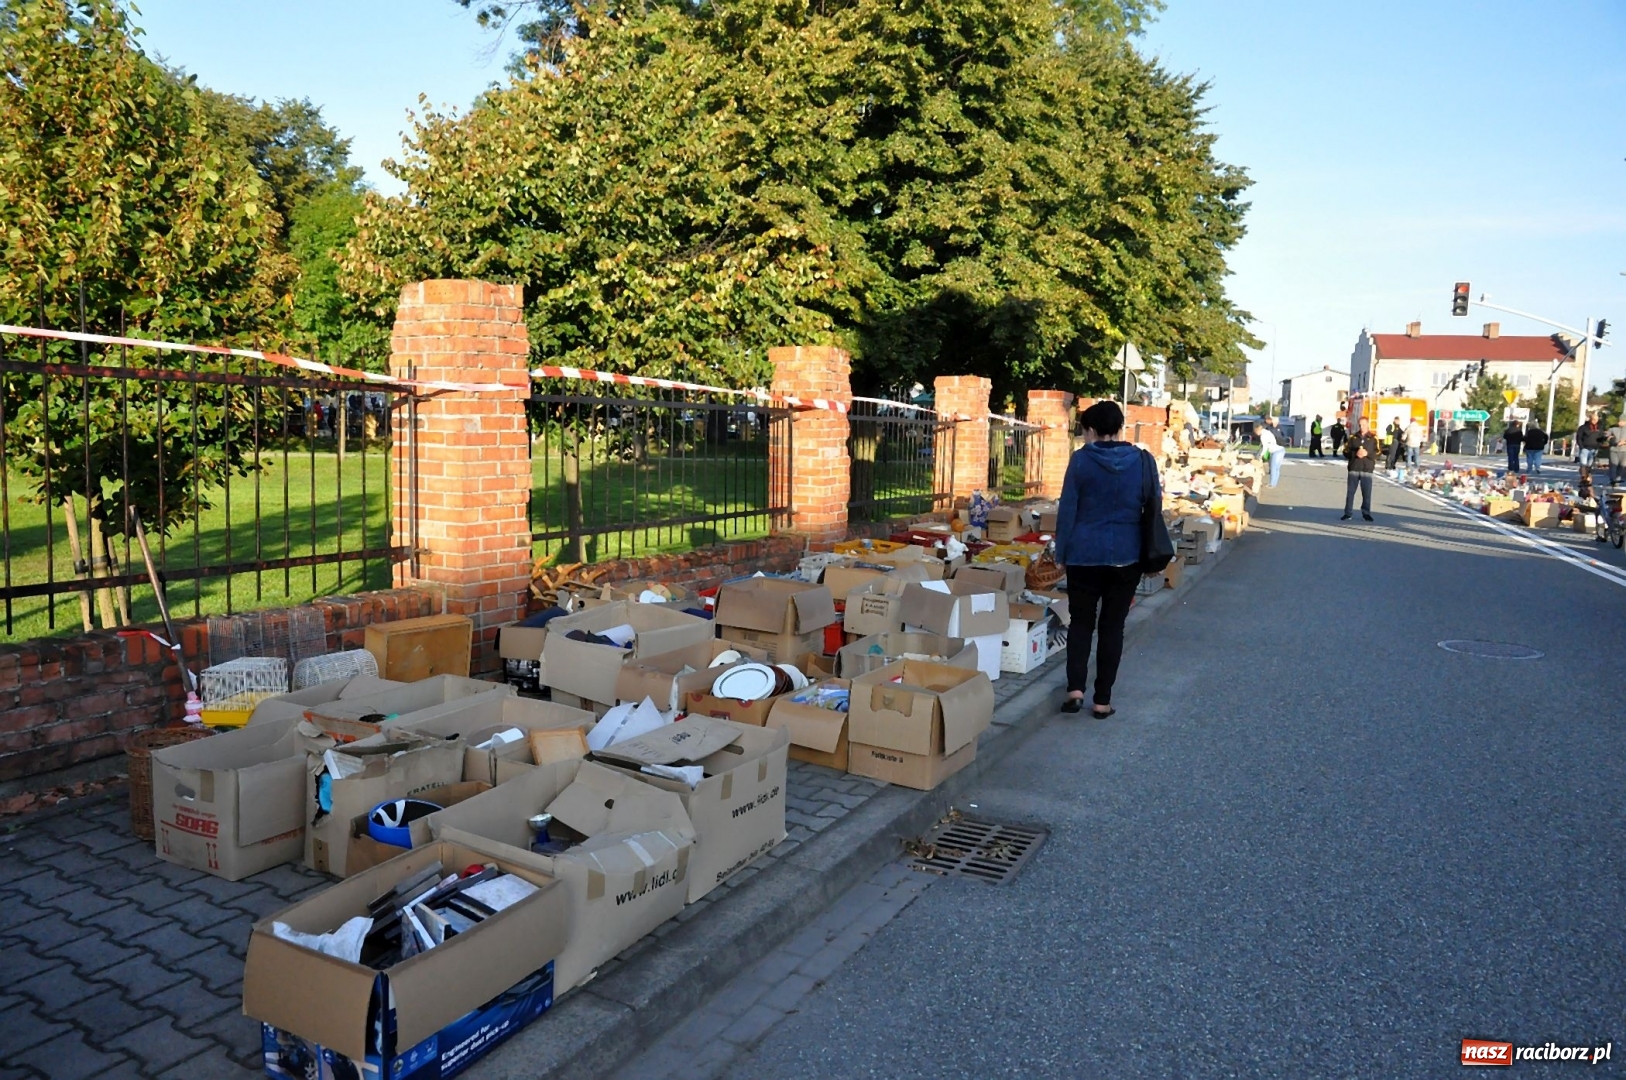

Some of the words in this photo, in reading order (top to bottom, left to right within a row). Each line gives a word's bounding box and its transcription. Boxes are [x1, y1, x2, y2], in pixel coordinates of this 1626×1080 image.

[1456, 411, 1483, 420] Rybnik
[731, 786, 780, 818] www.lidl.de
[175, 813, 219, 835] SORG
[441, 1028, 480, 1061] Engineered
[440, 1047, 470, 1072] superior
